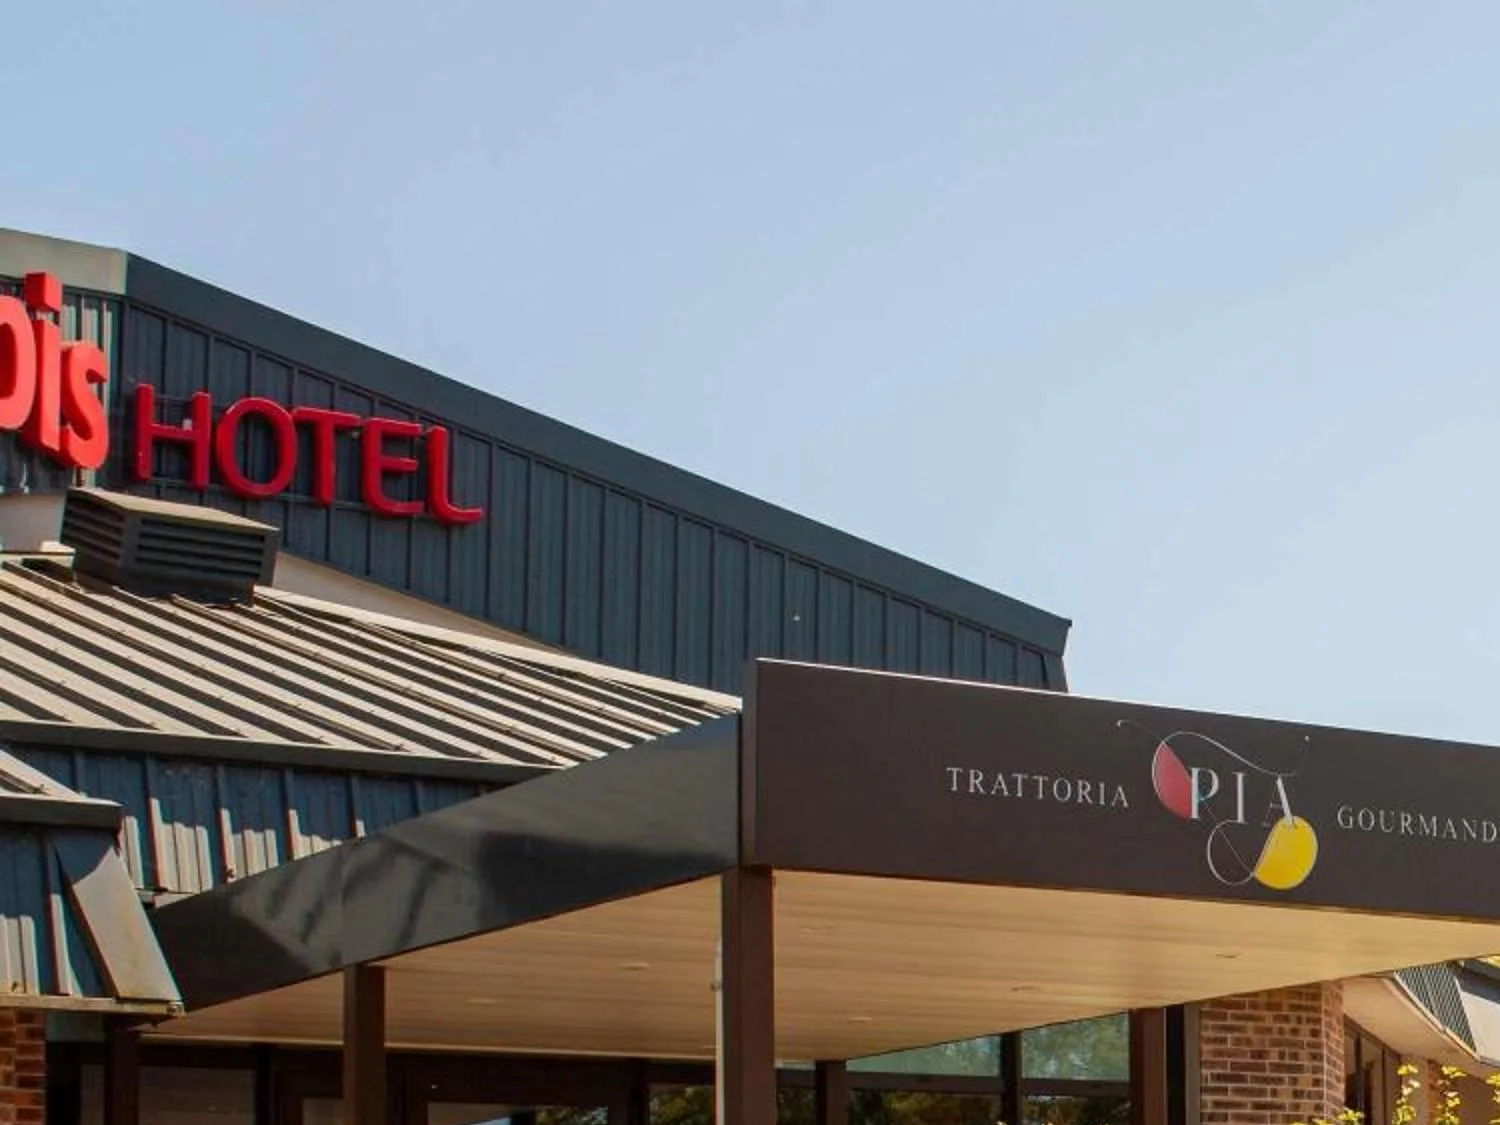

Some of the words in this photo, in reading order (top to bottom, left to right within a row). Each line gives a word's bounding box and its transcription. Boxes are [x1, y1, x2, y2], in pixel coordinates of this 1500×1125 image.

[134, 383, 483, 525] HOTEL
[946, 767, 1129, 808] TRATTORIA
[1189, 766, 1298, 829] PIA
